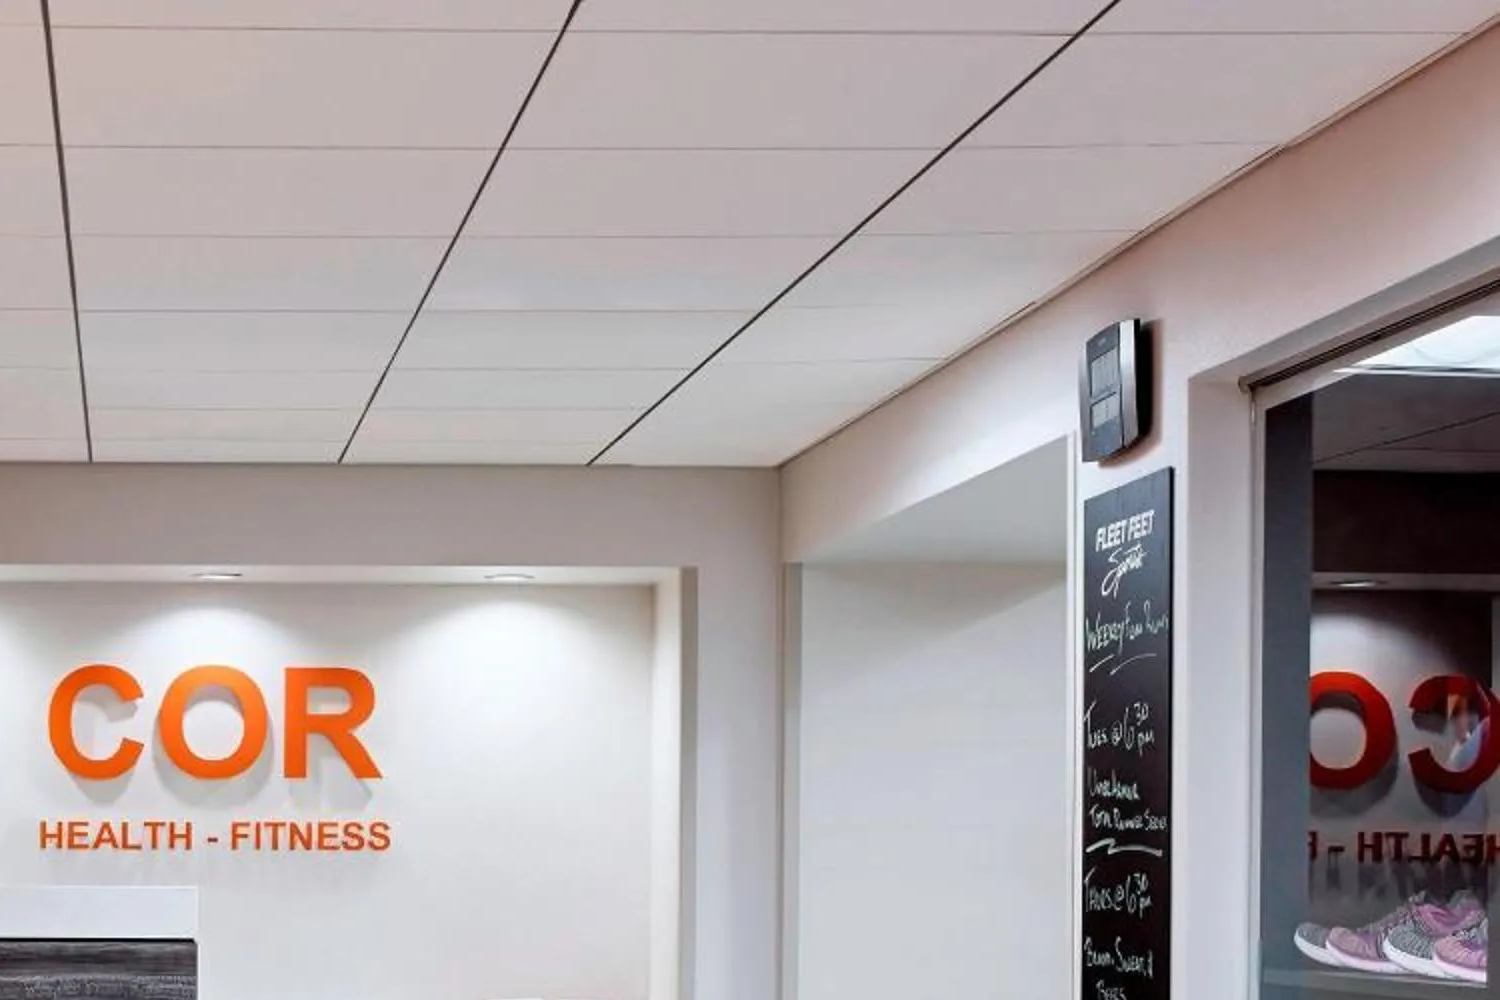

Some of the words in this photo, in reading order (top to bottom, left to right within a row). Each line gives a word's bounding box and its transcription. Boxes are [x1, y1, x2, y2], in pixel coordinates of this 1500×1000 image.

[1095, 519, 1127, 552] FLEET
[1127, 509, 1155, 542] FEET
[48, 664, 383, 781] COR
[39, 821, 193, 850] HEALTH
[231, 821, 392, 851] FITNESS
